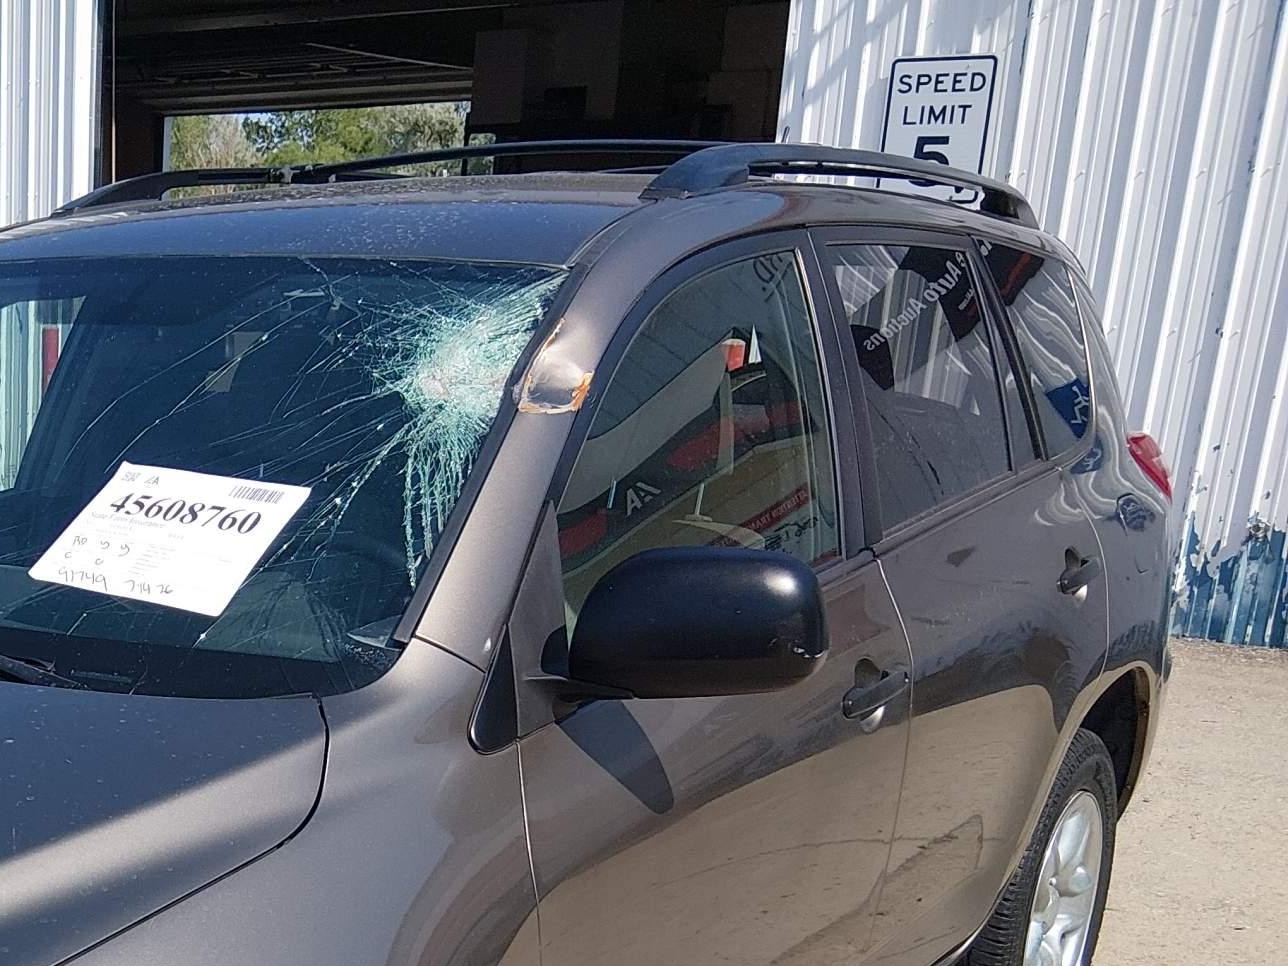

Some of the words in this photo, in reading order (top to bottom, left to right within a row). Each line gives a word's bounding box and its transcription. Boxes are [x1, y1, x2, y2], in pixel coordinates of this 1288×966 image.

[897, 72, 987, 94] SPEED
[902, 104, 973, 126] LIMIT
[109, 492, 262, 535] 45608760
